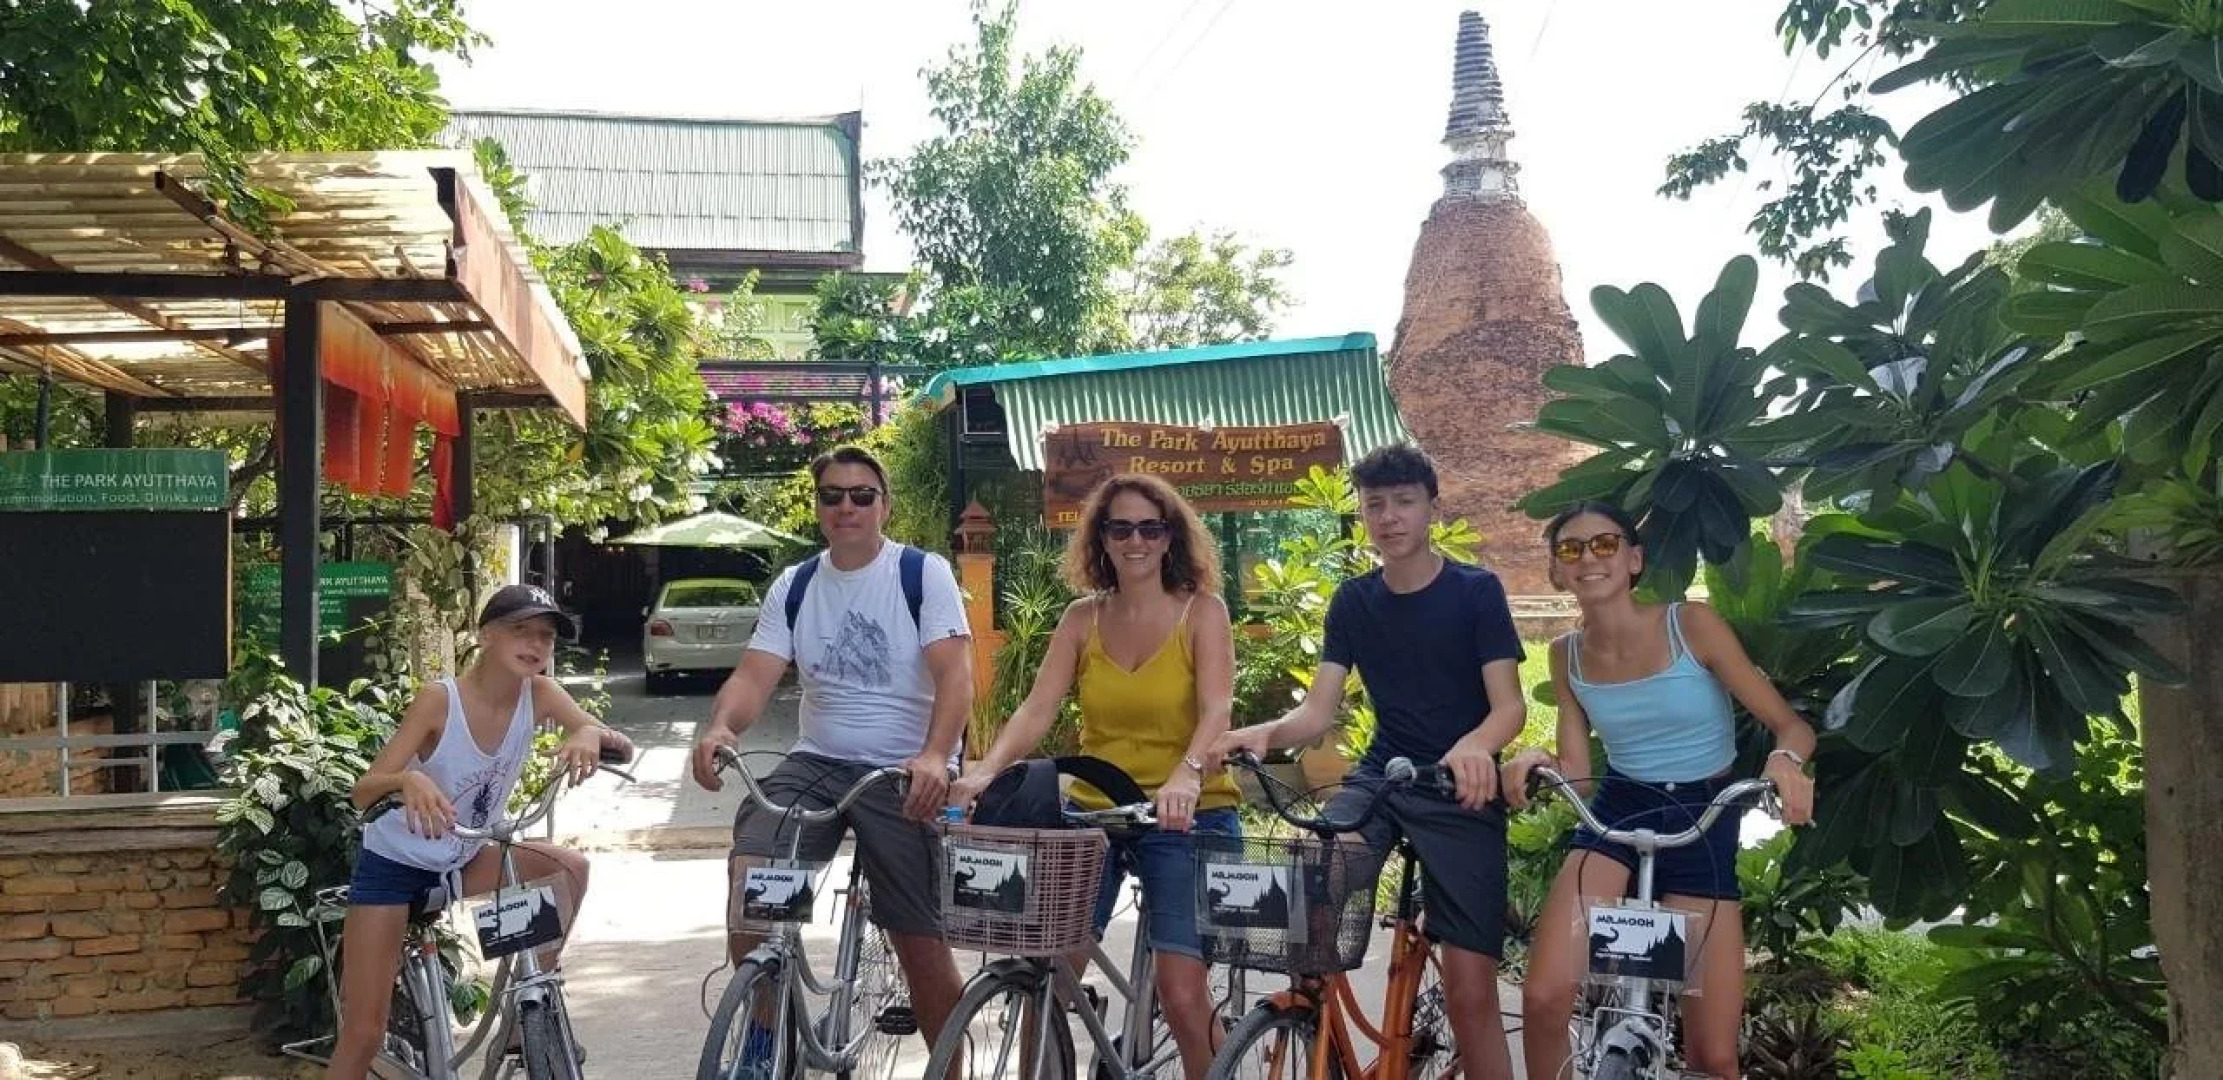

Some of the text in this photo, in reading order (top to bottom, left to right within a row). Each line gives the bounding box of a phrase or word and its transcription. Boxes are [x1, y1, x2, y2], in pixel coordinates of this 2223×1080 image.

[1101, 428, 1326, 455] The Park Ayutthaya
[1130, 455, 1293, 475] Resort & Spa
[41, 473, 217, 488] THE PARK AYUTTHAYA
